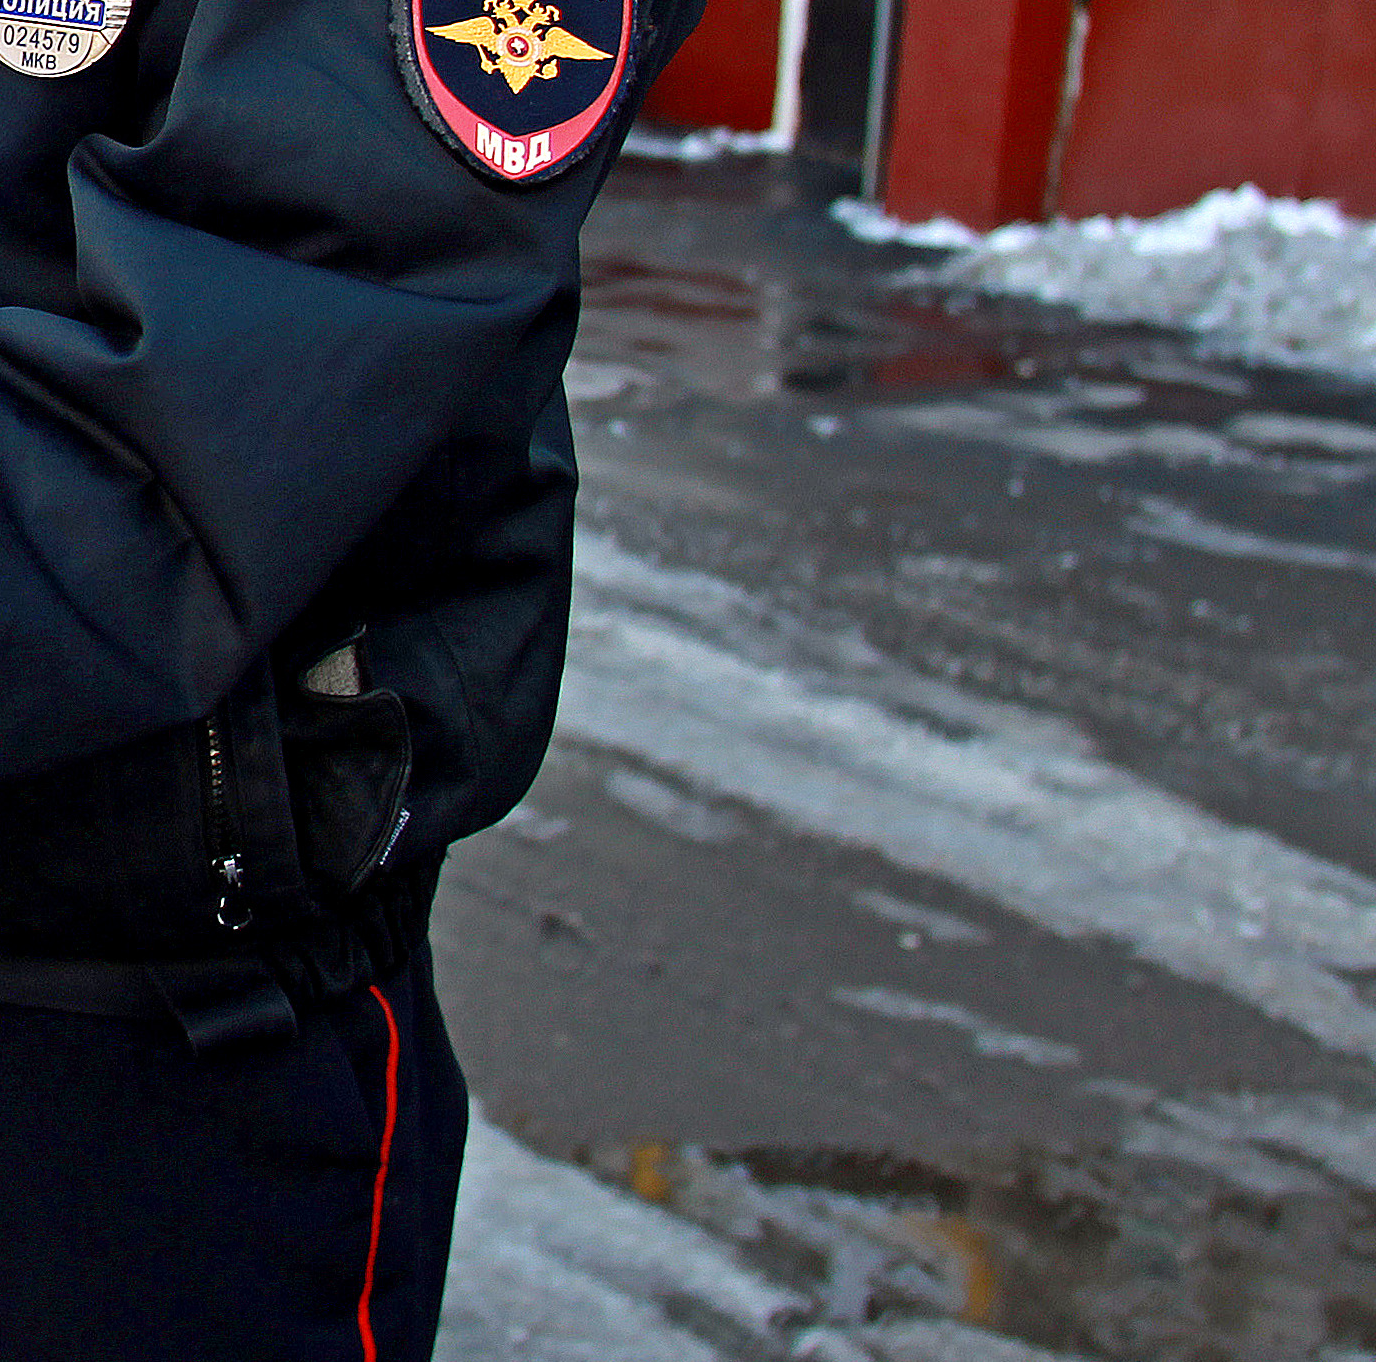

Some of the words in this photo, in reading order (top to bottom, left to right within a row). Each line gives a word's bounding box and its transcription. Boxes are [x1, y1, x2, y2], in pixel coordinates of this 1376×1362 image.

[3, 24, 81, 55] 024579
[21, 51, 57, 71] МКВ
[475, 122, 552, 175] МВД
